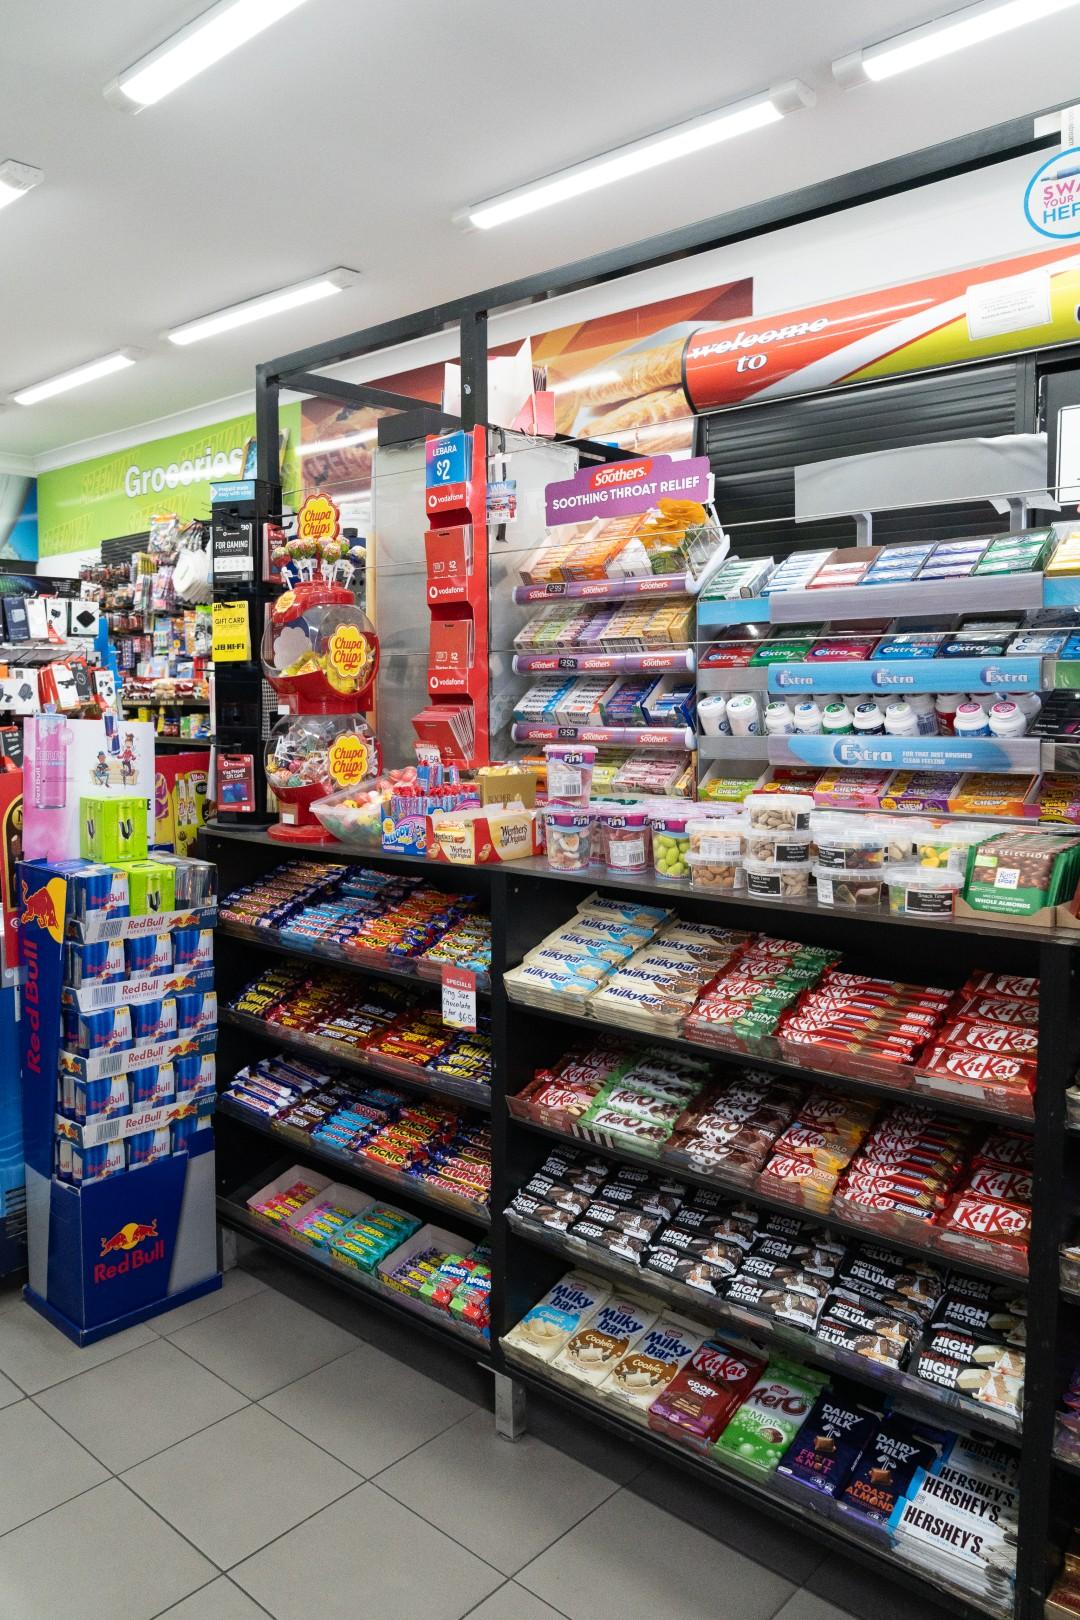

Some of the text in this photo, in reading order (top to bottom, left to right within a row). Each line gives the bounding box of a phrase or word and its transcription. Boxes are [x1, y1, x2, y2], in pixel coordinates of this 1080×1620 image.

[1044, 194, 1074, 208] YOUR
[687, 317, 829, 359] welcome
[736, 353, 768, 373] to
[433, 445, 457, 456] LEBARA
[124, 446, 243, 498] Groceries
[437, 459, 450, 480] $2
[595, 466, 647, 487] Soothers
[438, 494, 464, 504] vodafone
[552, 476, 700, 510] SOOTHING THROAT RELIEF
[305, 509, 332, 525] Chupa
[304, 522, 330, 538] Chups
[216, 540, 248, 550] FOR GAMING
[439, 586, 464, 594] vodafone
[582, 586, 608, 595] Soothers
[640, 581, 668, 591] Soothers
[335, 637, 362, 654] Chupa
[882, 646, 918, 654] extra
[946, 644, 984, 652] extra
[334, 650, 362, 666] Chups
[760, 650, 793, 658] extra
[642, 658, 672, 667] Soothers
[440, 678, 464, 686] vodafone
[780, 672, 812, 685] Extra
[877, 672, 914, 684] Extra
[986, 670, 1028, 682] Extra
[582, 732, 608, 741] Soothers
[640, 734, 669, 743] Soothers
[334, 748, 364, 762] Chupa
[841, 744, 892, 761] Extra
[333, 761, 362, 775] Chups
[501, 825, 528, 836] Werther's
[508, 834, 526, 844] Original
[1000, 850, 1049, 860] SELECTION
[998, 900, 1031, 908] ALMONDS
[128, 916, 164, 930] Red Bull
[678, 923, 731, 936] Milkybar
[654, 939, 706, 954] Milkybar
[540, 949, 584, 964] Milkybar
[645, 958, 698, 974] Milkybar
[447, 978, 472, 988] SPECIALS
[524, 967, 570, 983] Milkybar
[619, 968, 674, 984] Milkybar
[122, 980, 158, 994] Red Bull
[718, 982, 796, 999] KitKat MINT
[606, 987, 661, 1005] Milkybar
[23, 939, 41, 1073] Red Bull
[699, 1004, 778, 1022] KitKat MINT
[974, 1030, 1037, 1050] KitKat
[128, 1047, 164, 1063] Red Bull
[953, 1056, 1016, 1078] KitKat
[540, 1090, 578, 1106] KitKat
[611, 1090, 655, 1106] Aero
[126, 1112, 161, 1128] Red Bull
[596, 1113, 642, 1128] Aero
[700, 1116, 743, 1133] Aero
[390, 1125, 424, 1141] PICNIC
[367, 1145, 405, 1164] PICNIC
[688, 1140, 732, 1154] Aero
[442, 1166, 491, 1188] crunchie
[426, 1175, 478, 1198] crunchie
[602, 1189, 632, 1200] CRISP
[849, 1192, 930, 1218] KitKat CHUNKY
[586, 1209, 615, 1222] CRISP
[960, 1204, 1022, 1232] KitKat
[94, 1240, 164, 1284] Red Bull
[440, 1264, 467, 1276] Nerds
[854, 1259, 884, 1274] PROTEIN
[850, 1266, 896, 1290] DELUXE
[550, 1296, 580, 1314] bar
[551, 1284, 595, 1310] Milky
[598, 1306, 644, 1332] Milky
[829, 1306, 874, 1330] DELUXE
[945, 1310, 986, 1328] PROTEIN
[948, 1301, 990, 1321] HIGH
[598, 1319, 628, 1337] bar
[585, 1334, 616, 1350] Cookies
[644, 1331, 692, 1358] Milky
[932, 1336, 974, 1355] HIGH
[644, 1344, 676, 1361] bar
[632, 1358, 664, 1374] Cookies
[696, 1352, 746, 1379] KitKat
[918, 1357, 959, 1380] HIGH
[687, 1379, 719, 1398] GOOEY
[690, 1386, 710, 1398] CHOC
[750, 1387, 809, 1416] Aero
[750, 1410, 780, 1427] Mint
[820, 1413, 852, 1430] MILK
[822, 1404, 865, 1424] DAIRY
[876, 1433, 920, 1456] DAIRY
[875, 1442, 908, 1464] MILK
[854, 1480, 894, 1500] ROAST
[940, 1466, 1015, 1508] HERSHEY'S
[846, 1486, 894, 1512] ALMOND
[923, 1477, 1001, 1523] HERSHEY'S
[904, 1505, 984, 1554] HERSHEY'S
